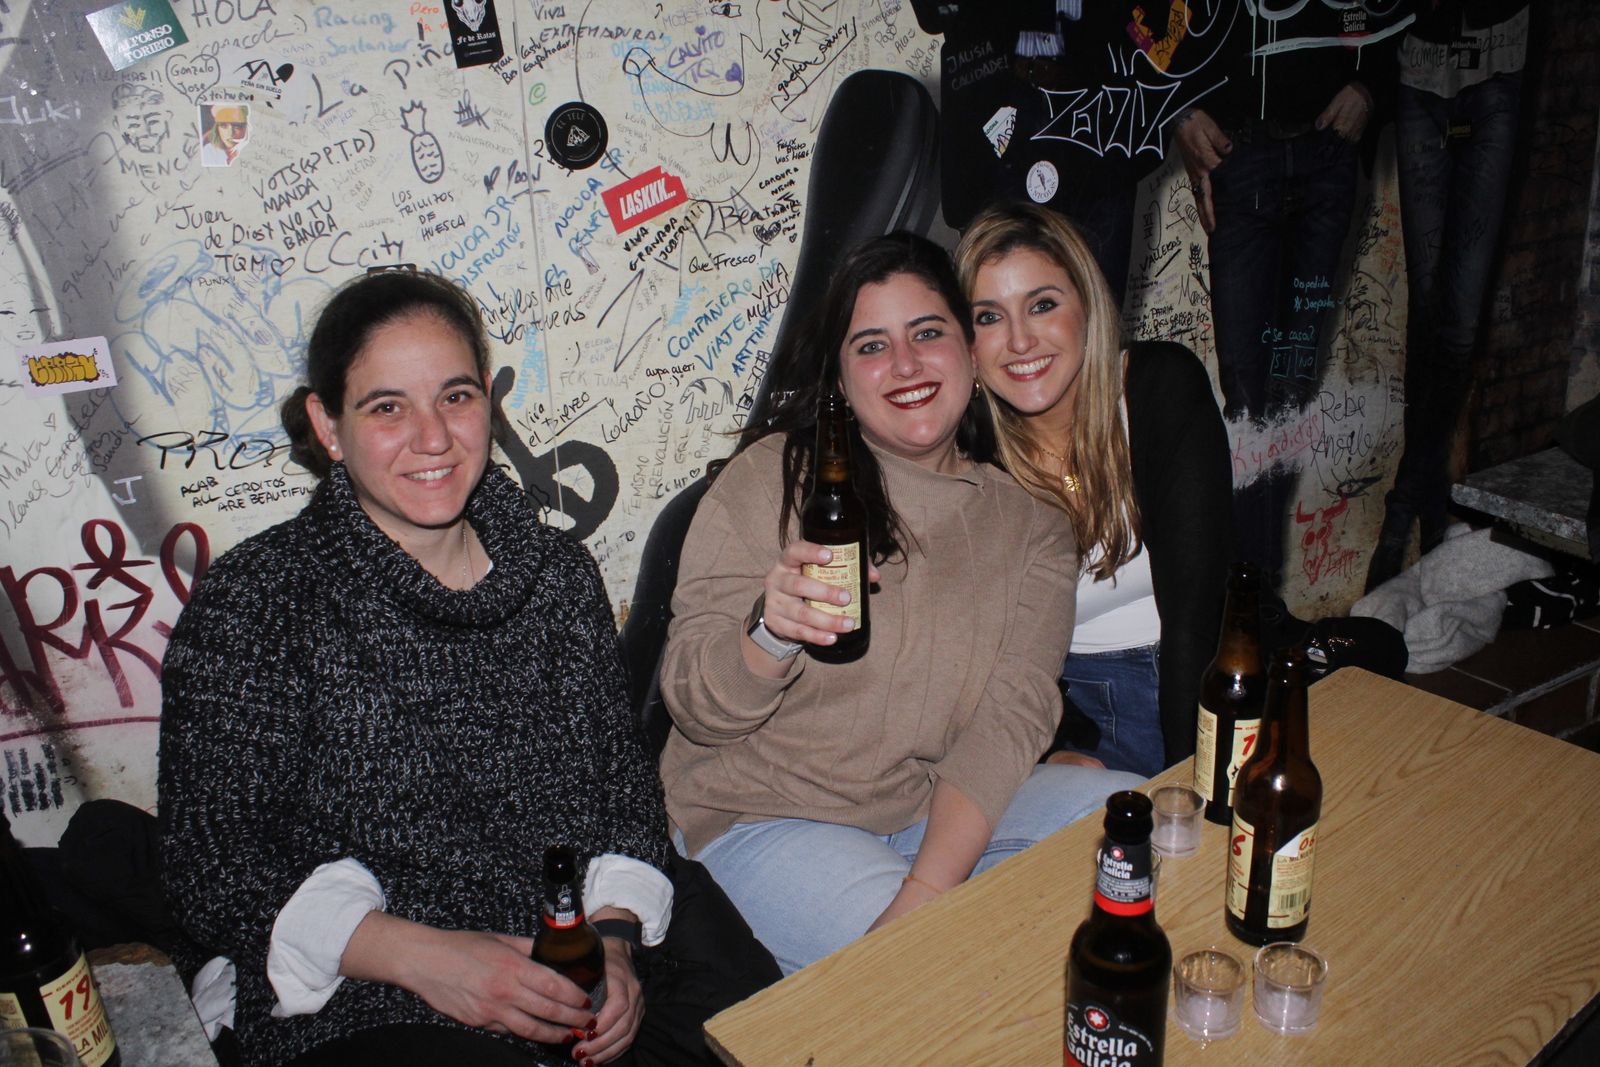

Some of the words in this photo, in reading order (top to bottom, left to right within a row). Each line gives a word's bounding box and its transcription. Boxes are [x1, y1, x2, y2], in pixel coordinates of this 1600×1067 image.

[191, 0, 277, 28] HOLA
[314, 6, 397, 35] Racing
[117, 24, 173, 51] ALFONSO
[124, 38, 175, 65] TORIBIO
[263, 177, 320, 214] MANDA
[173, 204, 232, 231] Juan
[278, 211, 303, 234] NO
[306, 195, 333, 219] TU
[418, 211, 437, 225] DE
[420, 214, 467, 242] HUESCA
[204, 228, 222, 250] de
[667, 279, 754, 358] COMPAÑERO
[694, 312, 747, 371] VIAJE
[600, 381, 667, 444] LOGROÑO
[217, 499, 247, 513] ARE
[1102, 853, 1134, 871] Estrella
[1102, 865, 1131, 880] Galicia
[1066, 1011, 1139, 1057] Estrella
